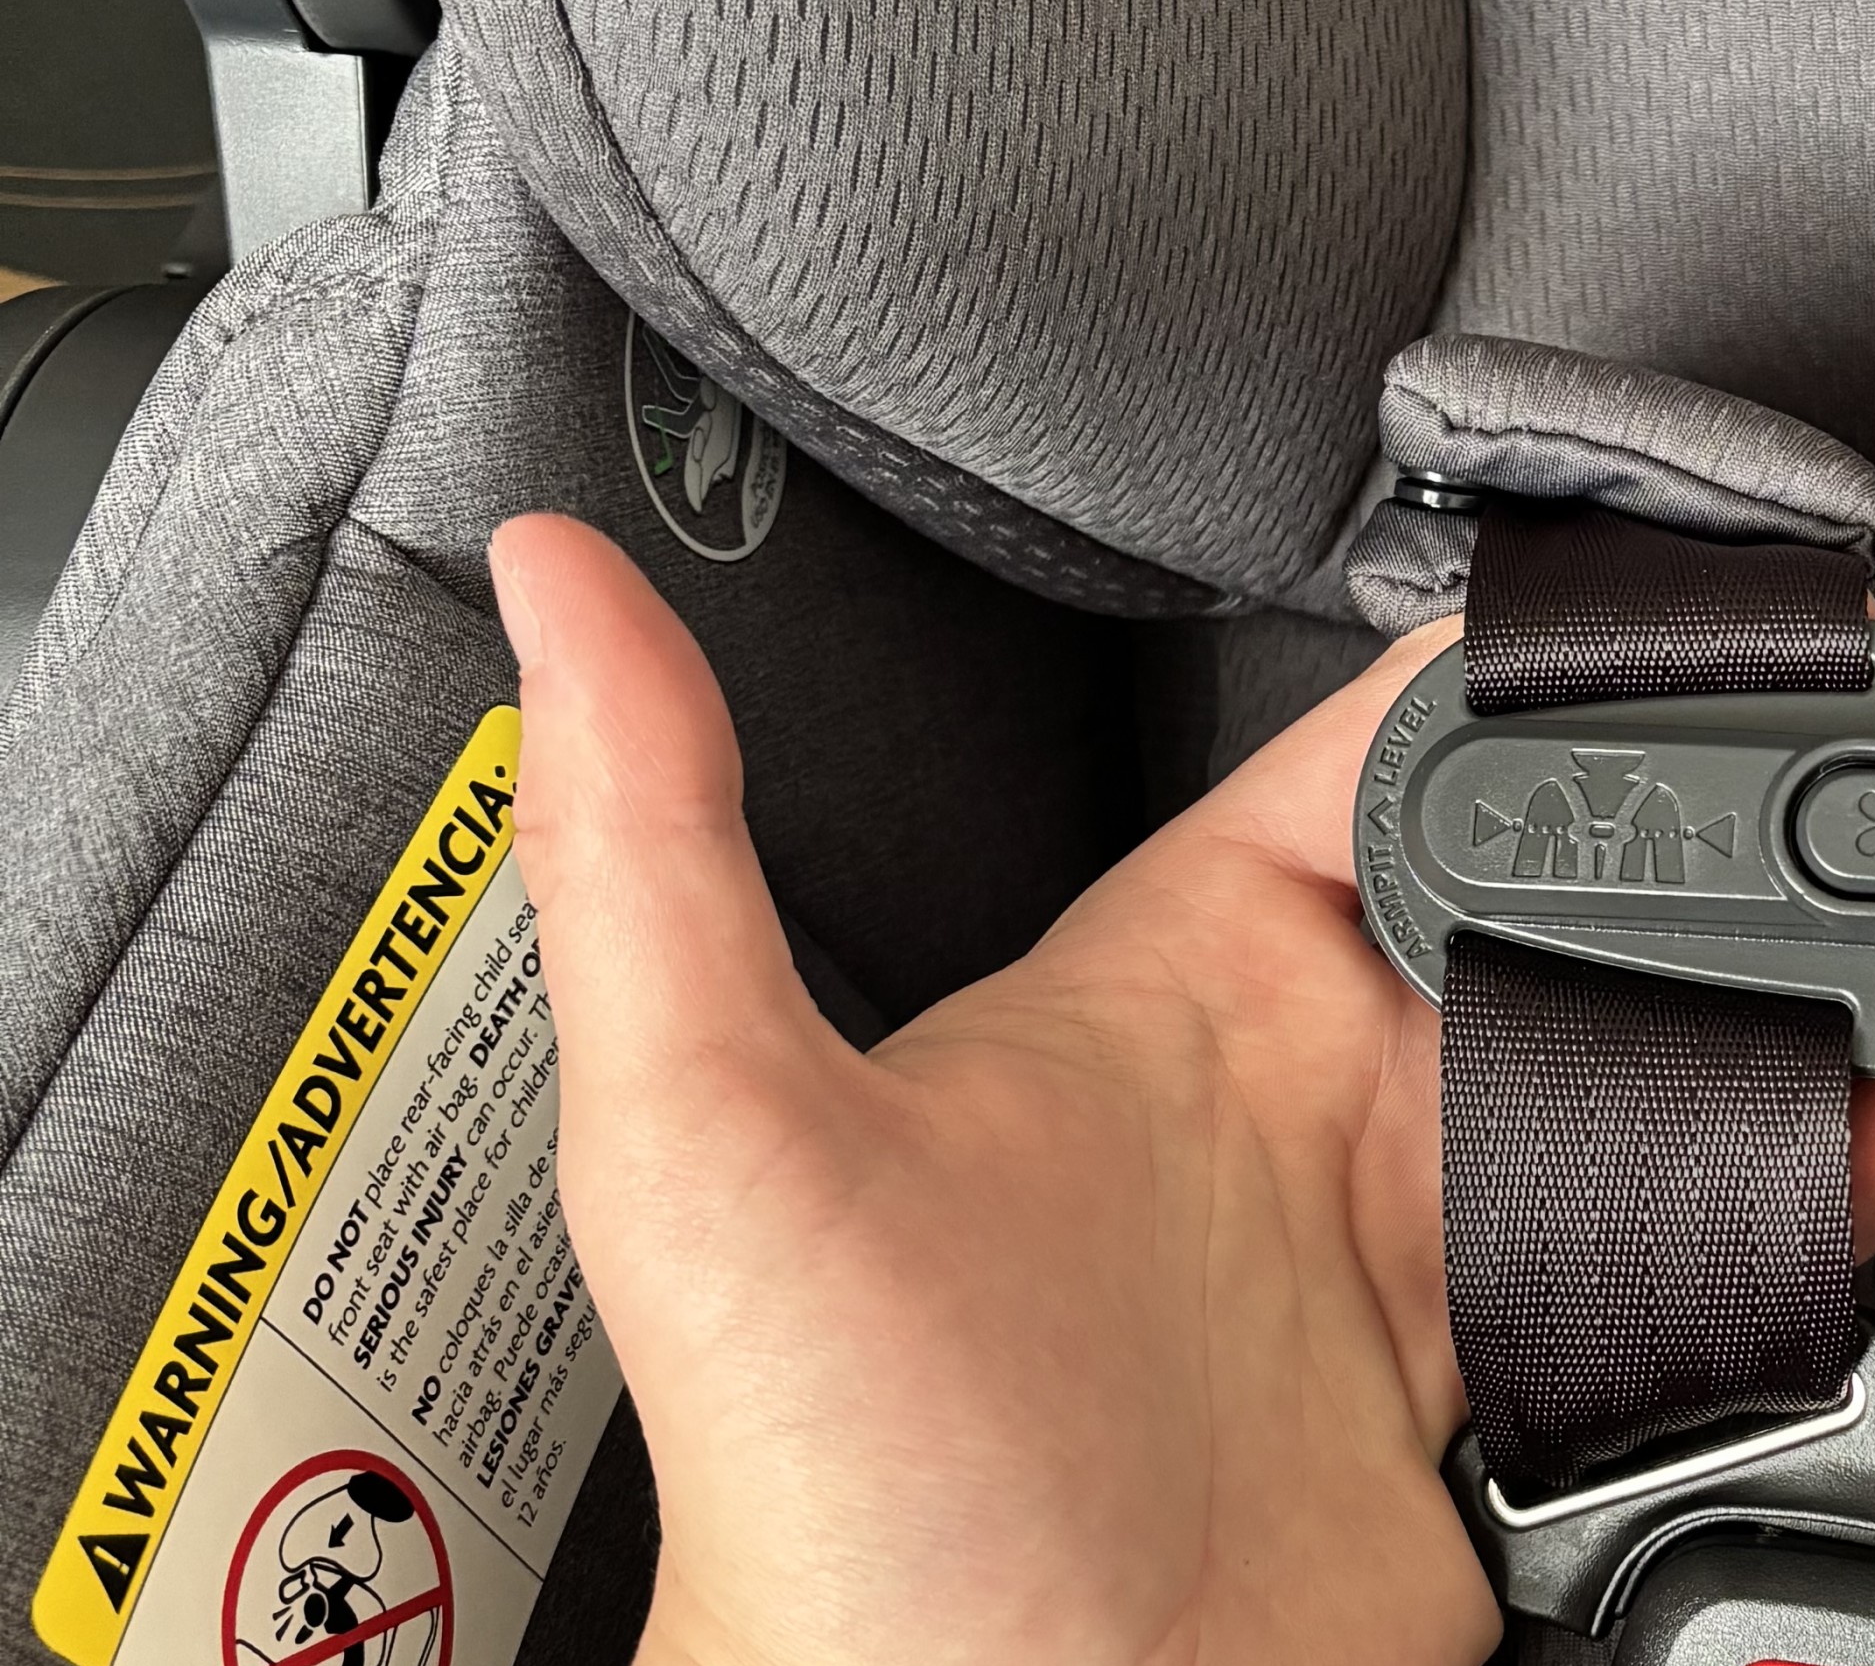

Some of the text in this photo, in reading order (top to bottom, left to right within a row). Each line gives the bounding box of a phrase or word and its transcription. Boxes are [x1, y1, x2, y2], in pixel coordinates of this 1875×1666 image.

[1367, 696, 1437, 960] ARMPIT LEVEL
[102, 764, 518, 1519] WARNING/ADVERTENCIA:
[302, 893, 538, 1326] DO NOT place rear-facing child sea
[327, 1275, 371, 1346] front
[365, 1218, 399, 1277] seat
[392, 1159, 429, 1216] with
[423, 1121, 446, 1158] air
[437, 1073, 478, 1123] bag.
[468, 975, 528, 1069] DEATH
[353, 991, 551, 1370] SERIOUS INJURY can occur. Th
[375, 1368, 397, 1392] is
[389, 1319, 419, 1365] the
[414, 1238, 457, 1318] safest
[451, 1171, 491, 1245] place
[483, 1128, 512, 1170] for
[410, 1155, 549, 1426] NO coloques la silla de
[431, 1179, 561, 1447] hacia atrás en el asien
[458, 1226, 571, 1468] airbag. Puede ocasi
[475, 1256, 584, 1489] LESIONES GRAVE
[500, 1298, 596, 1508] el lugar más segu
[516, 1439, 566, 1528] 12 años.
